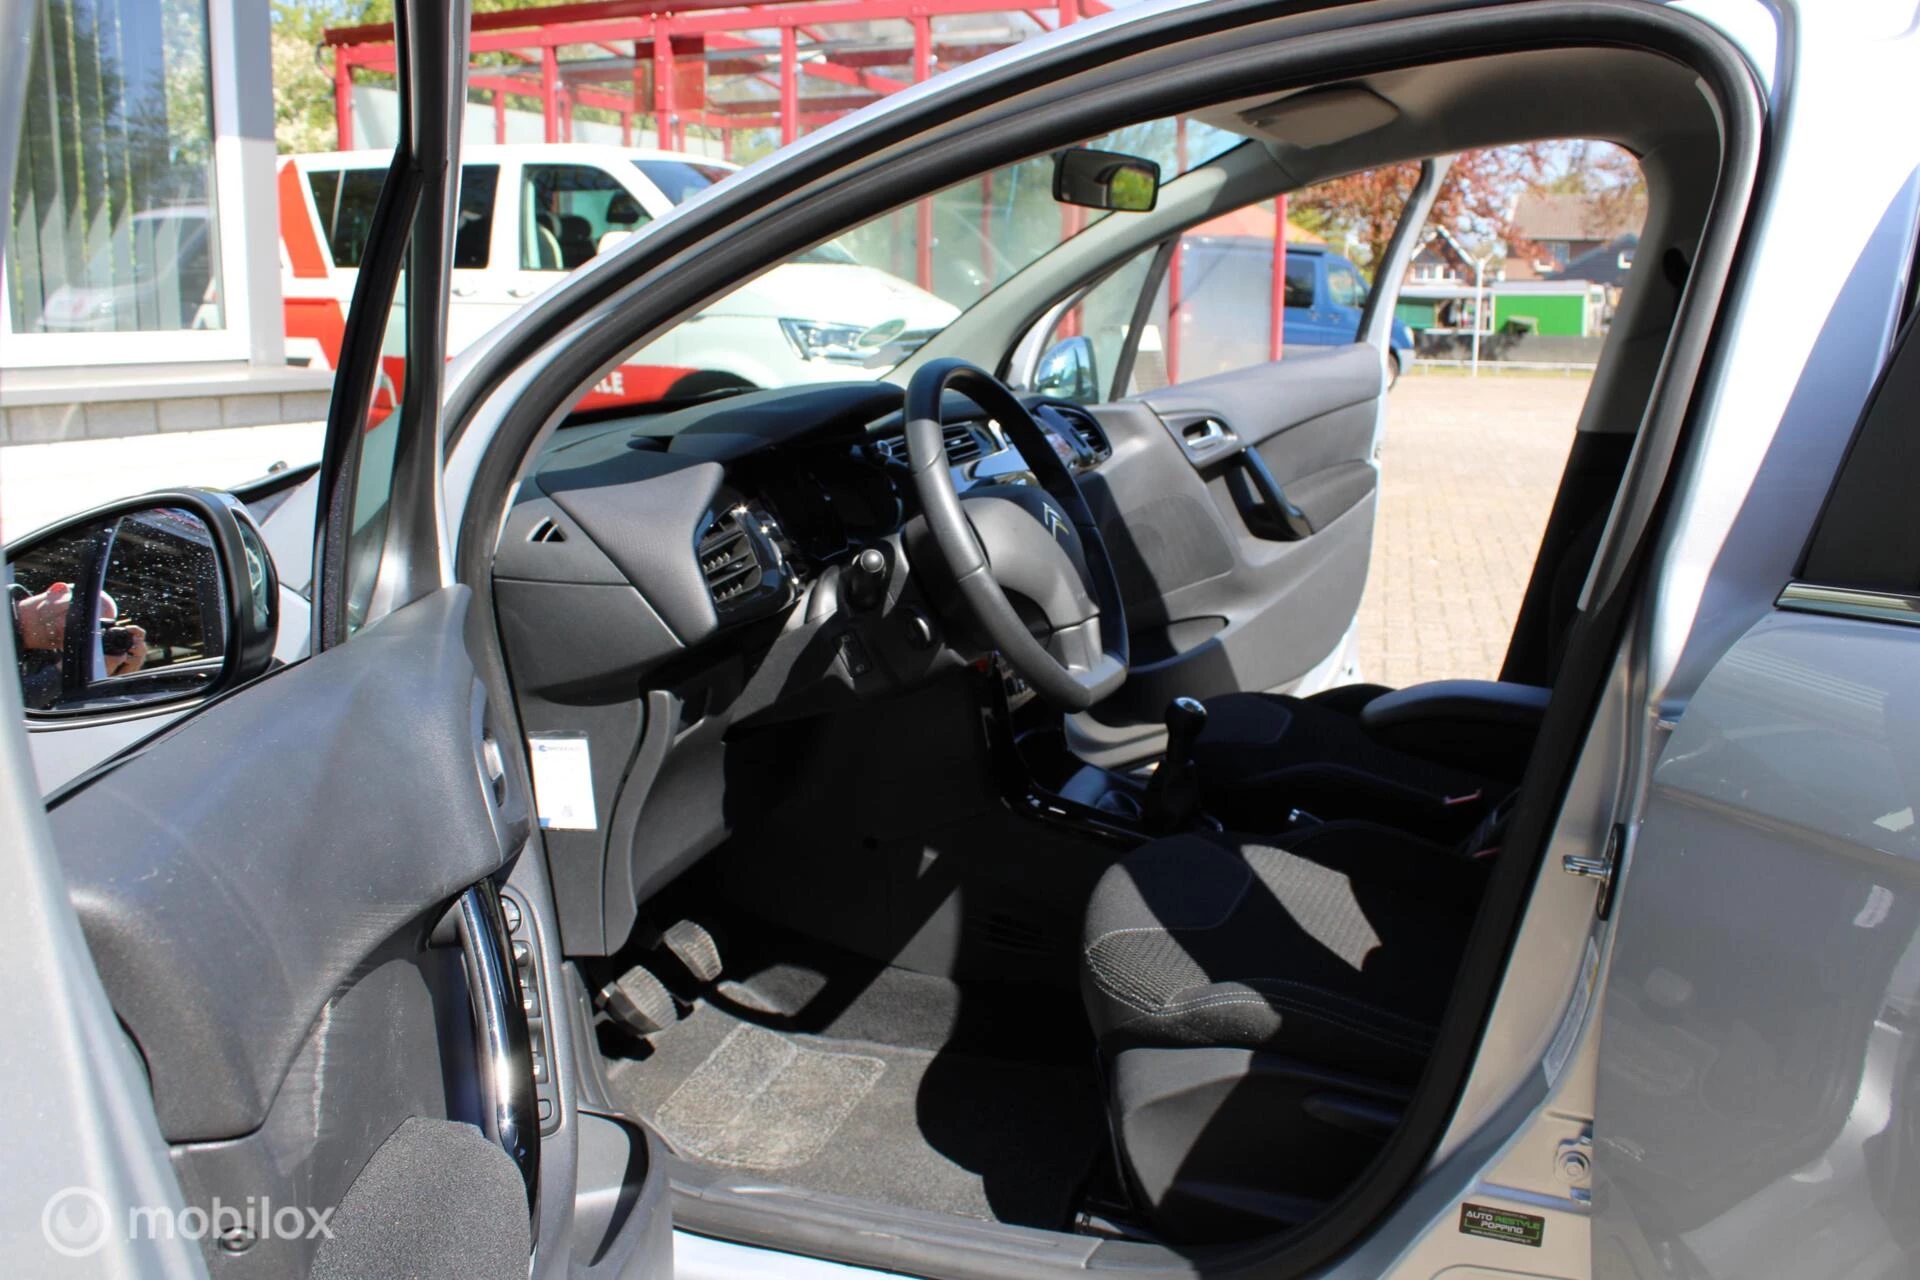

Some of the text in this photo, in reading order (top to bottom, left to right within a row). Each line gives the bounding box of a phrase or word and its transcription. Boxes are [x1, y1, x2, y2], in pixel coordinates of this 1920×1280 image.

[1466, 1210, 1493, 1221] AUTO
[1494, 1215, 1540, 1230] RESTYLE
[1480, 1220, 1524, 1235] POPPING
